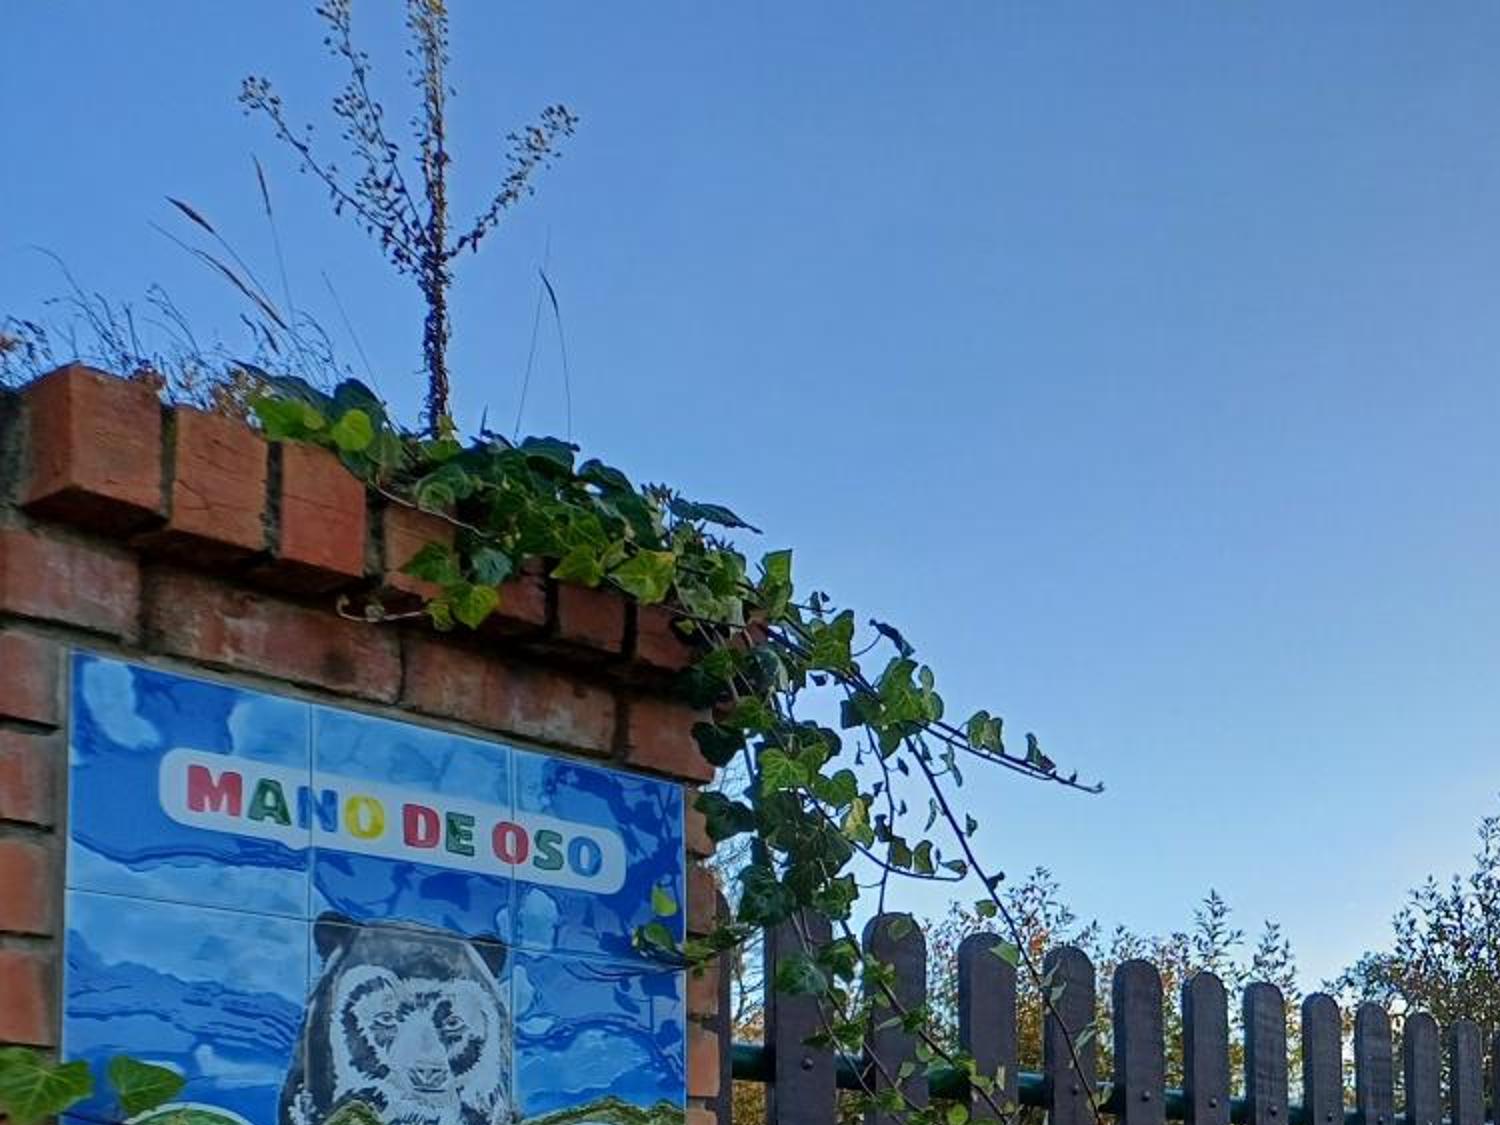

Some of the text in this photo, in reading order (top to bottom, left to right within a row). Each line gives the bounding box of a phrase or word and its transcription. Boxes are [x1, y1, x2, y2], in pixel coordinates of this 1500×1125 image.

[187, 764, 603, 877] MANO DE OSO
